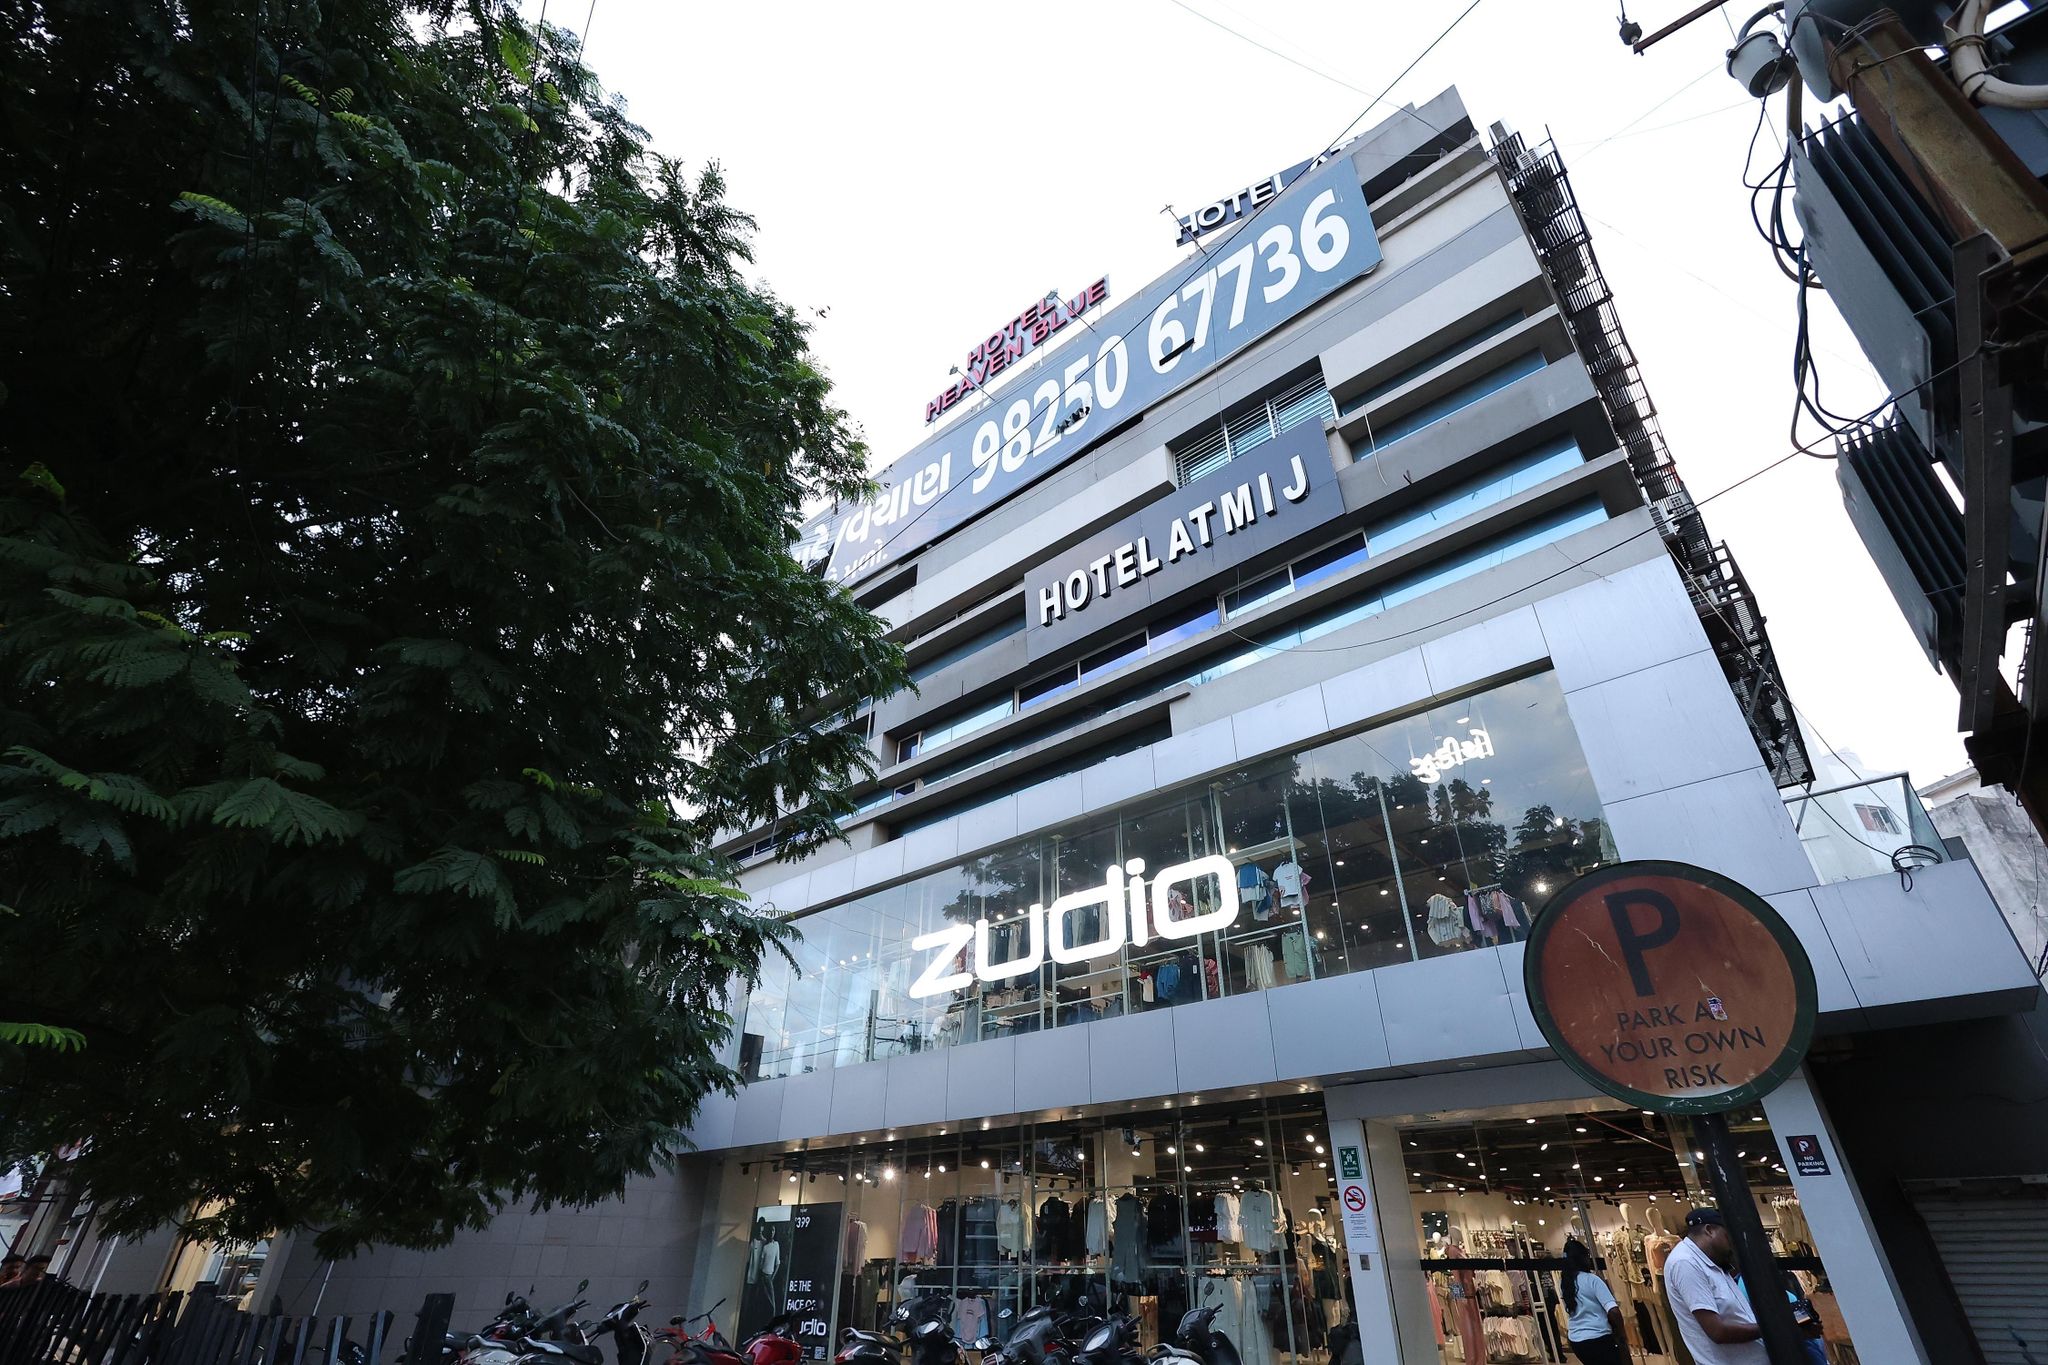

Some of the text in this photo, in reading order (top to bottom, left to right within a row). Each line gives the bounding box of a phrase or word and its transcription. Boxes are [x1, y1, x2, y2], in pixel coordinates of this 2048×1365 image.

[1175, 173, 1291, 241] HOTEL
[925, 278, 1107, 422] HEAVEN BLUE
[967, 297, 1056, 371] HOTEL
[972, 335, 1128, 494] 98250
[1147, 189, 1349, 374] 67736
[1039, 454, 1311, 627] HOTEL ATMIJ
[909, 854, 1240, 999] zudio
[1604, 888, 1681, 998] P
[1601, 1026, 1767, 1065] YOUR OWN
[1616, 1000, 1727, 1033] PARK A
[1664, 1063, 1729, 1090] RISK
[786, 1298, 805, 1312] FACE
[788, 1280, 812, 1292] BE THE
[799, 1318, 827, 1336] udio
